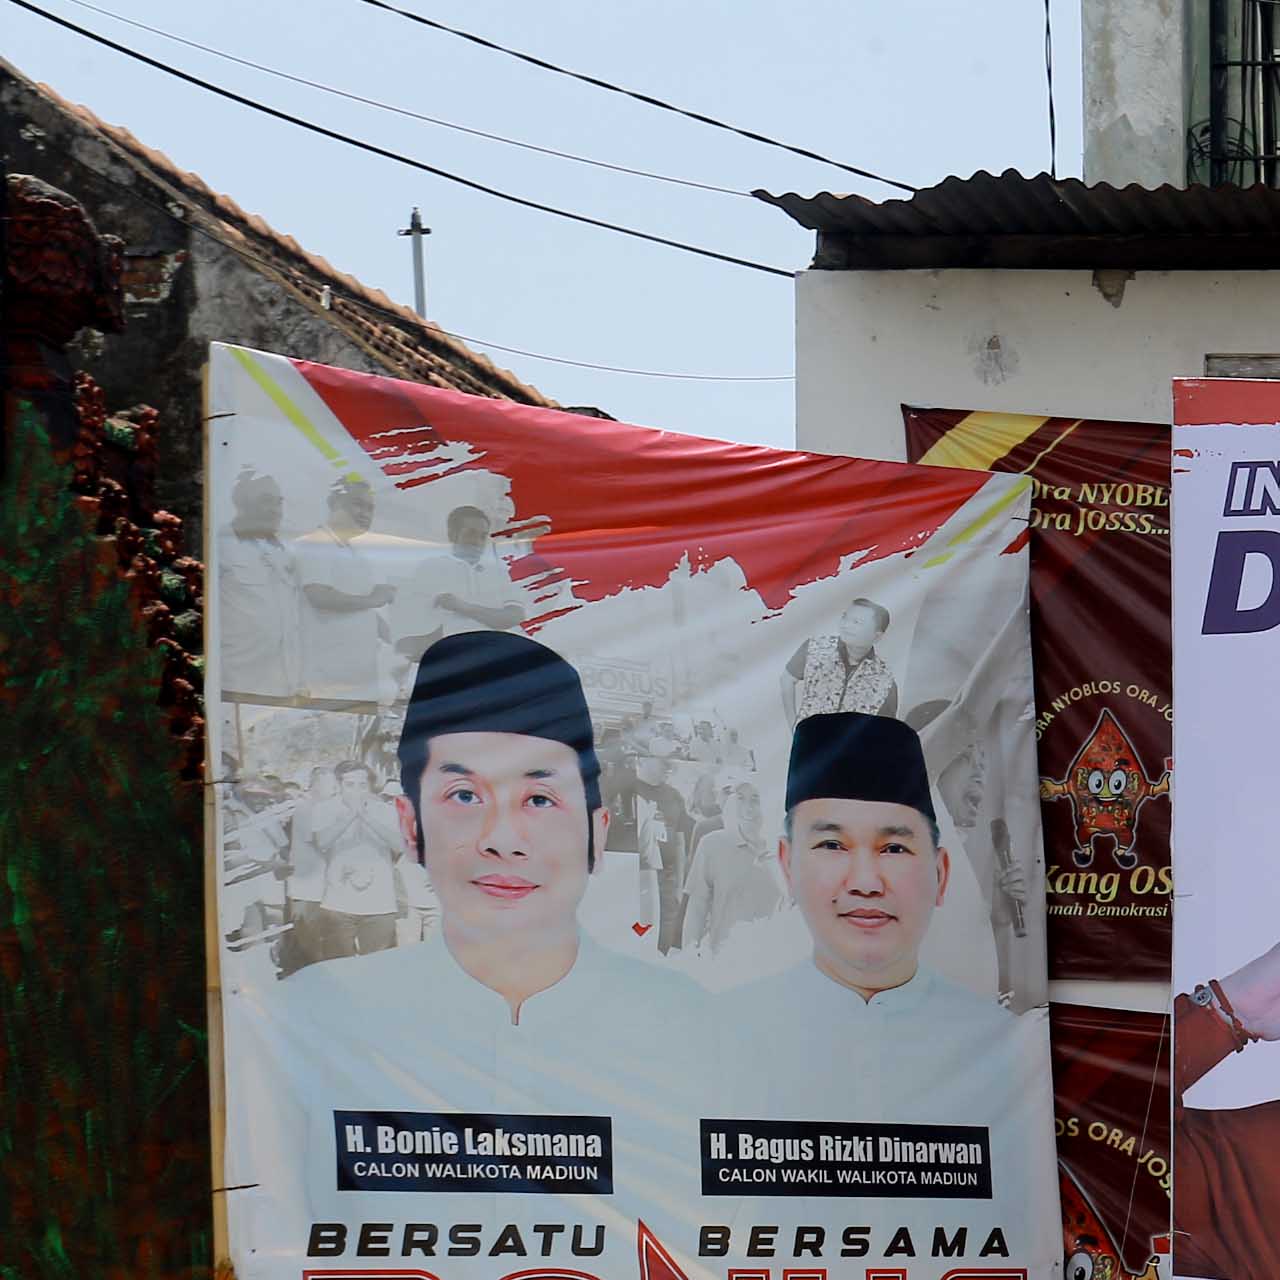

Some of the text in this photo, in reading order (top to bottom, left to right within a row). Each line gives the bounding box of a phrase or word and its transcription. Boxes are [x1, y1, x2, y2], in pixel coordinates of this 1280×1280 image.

[1051, 680, 1121, 713] NYOBLOS
[1126, 685, 1159, 709] ORA
[1086, 902, 1168, 917] Demokrasi
[345, 1124, 603, 1158] H. Bonie Laksmana
[709, 1132, 983, 1165] H. Bagus Rizki Dinarwan
[1088, 1121, 1136, 1156] ORA
[353, 1161, 599, 1181] CALON WALIKOTA MADIUN
[718, 1168, 978, 1187] CALON WAKIL WALIKOTA MADIUN
[304, 1223, 606, 1258] BERSATU
[697, 1225, 1011, 1258] BERSAMA
